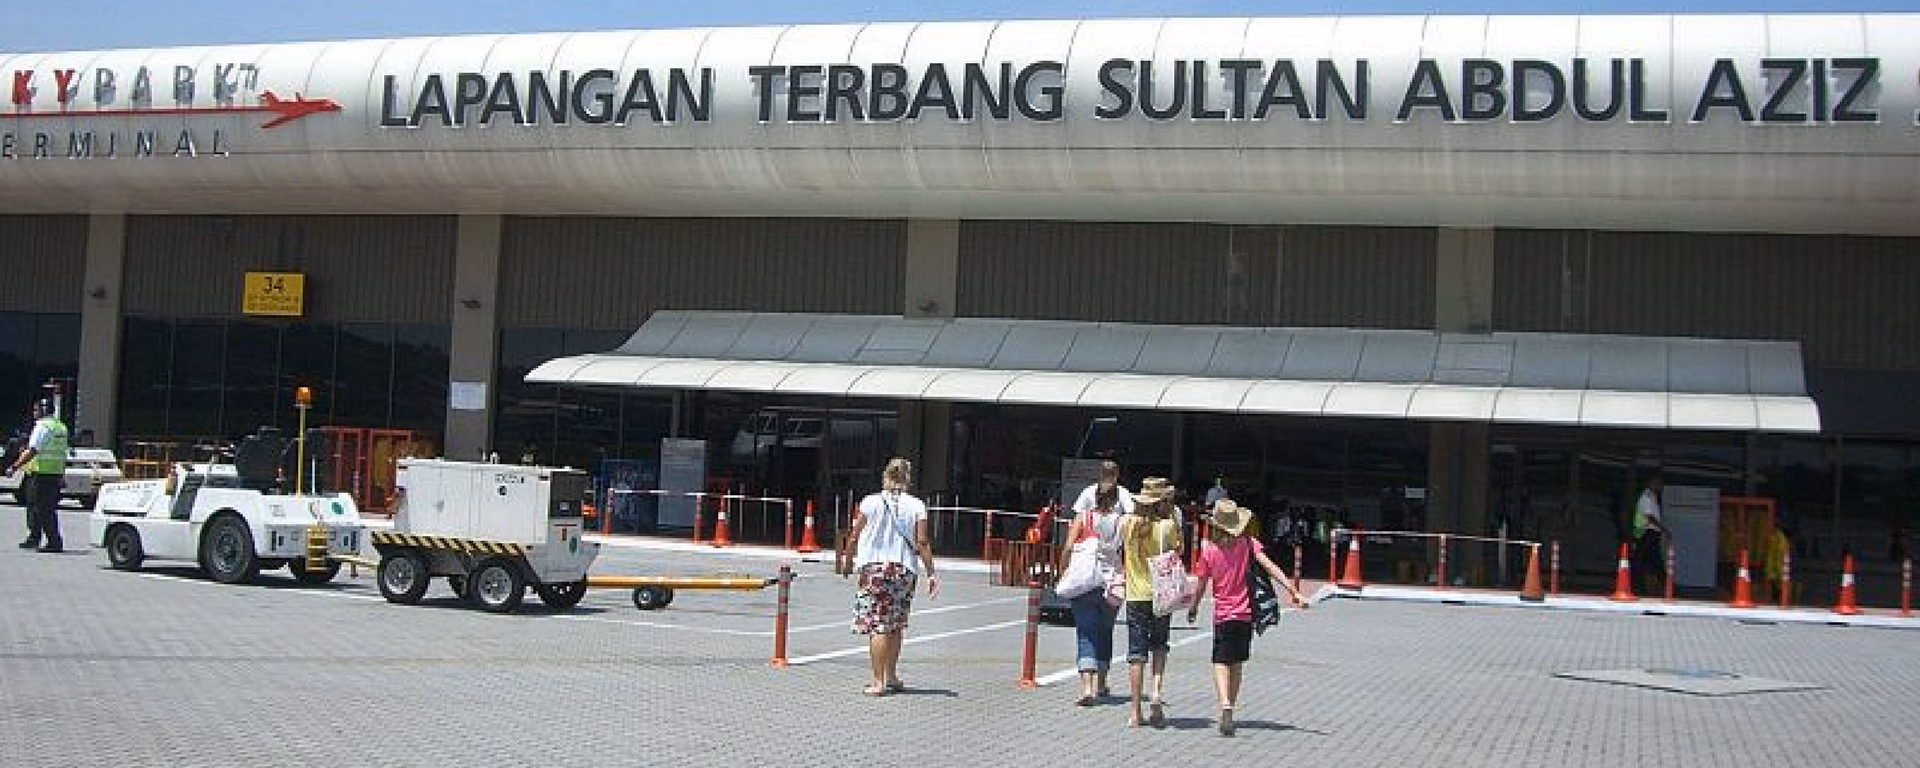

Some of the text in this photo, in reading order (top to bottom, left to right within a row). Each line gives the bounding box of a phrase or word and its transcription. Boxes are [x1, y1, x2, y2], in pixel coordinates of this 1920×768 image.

[381, 67, 712, 127] LAPANGAN
[748, 60, 1065, 122] TERBANG
[1094, 58, 1368, 120] SULTAN
[1397, 57, 1669, 122] ABDUL
[1691, 57, 1881, 122] AZIZ
[2, 130, 229, 158] ERMINAL
[262, 276, 287, 294] 34
